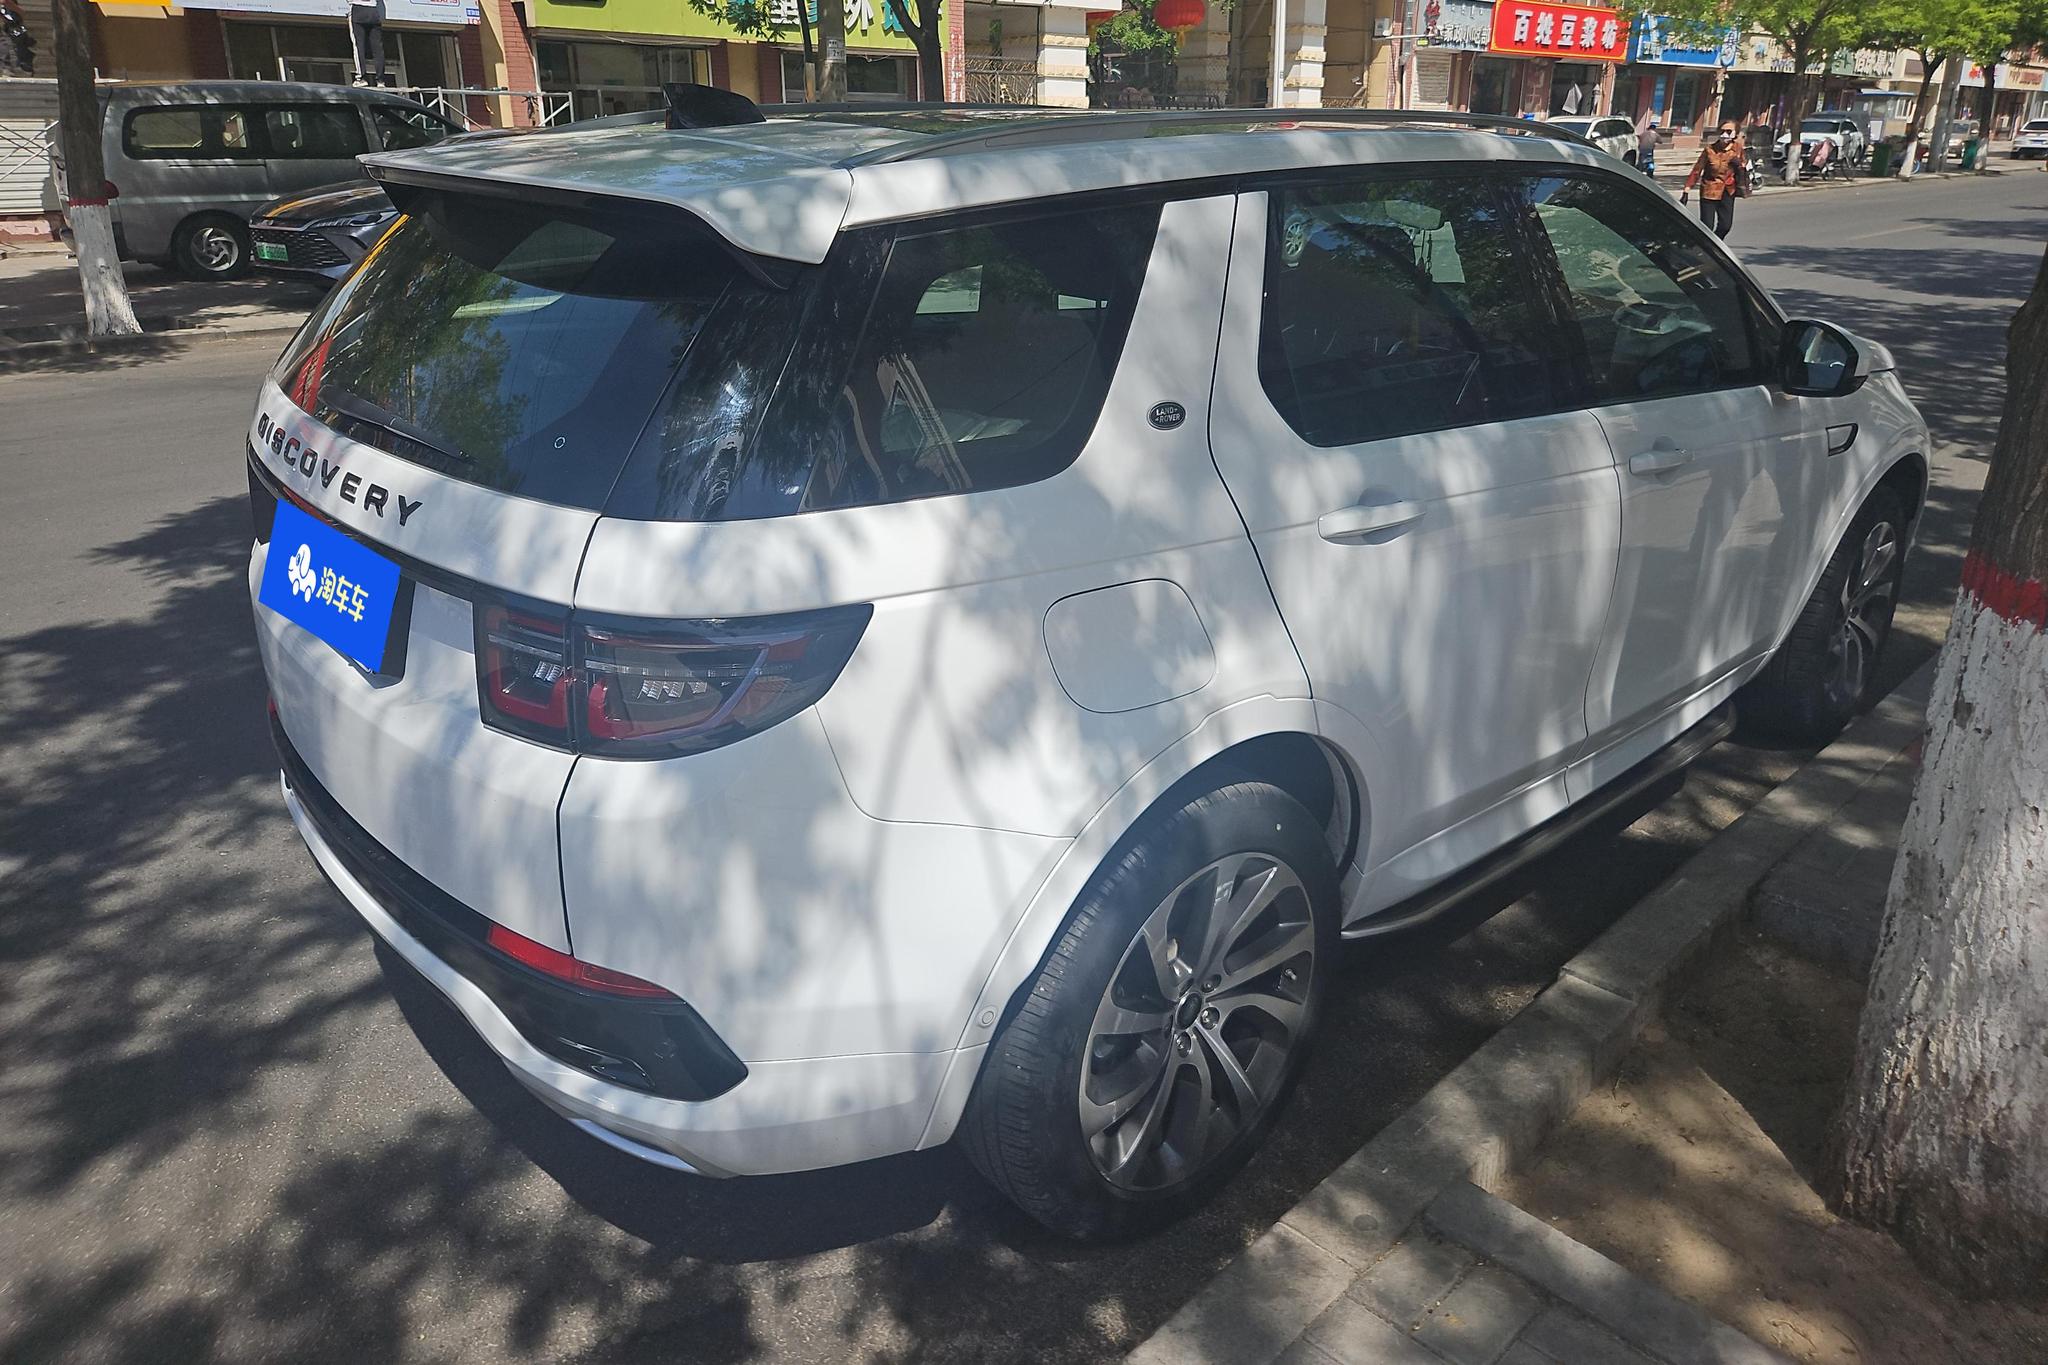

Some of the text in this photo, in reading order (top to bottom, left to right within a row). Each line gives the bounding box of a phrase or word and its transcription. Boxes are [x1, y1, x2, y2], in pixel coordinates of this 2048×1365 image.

[1514, 9, 1619, 49] 百姓豆浆坊
[1156, 407, 1174, 415] LAND
[1159, 413, 1181, 423] ROVER
[257, 412, 423, 527] DISCOVERY
